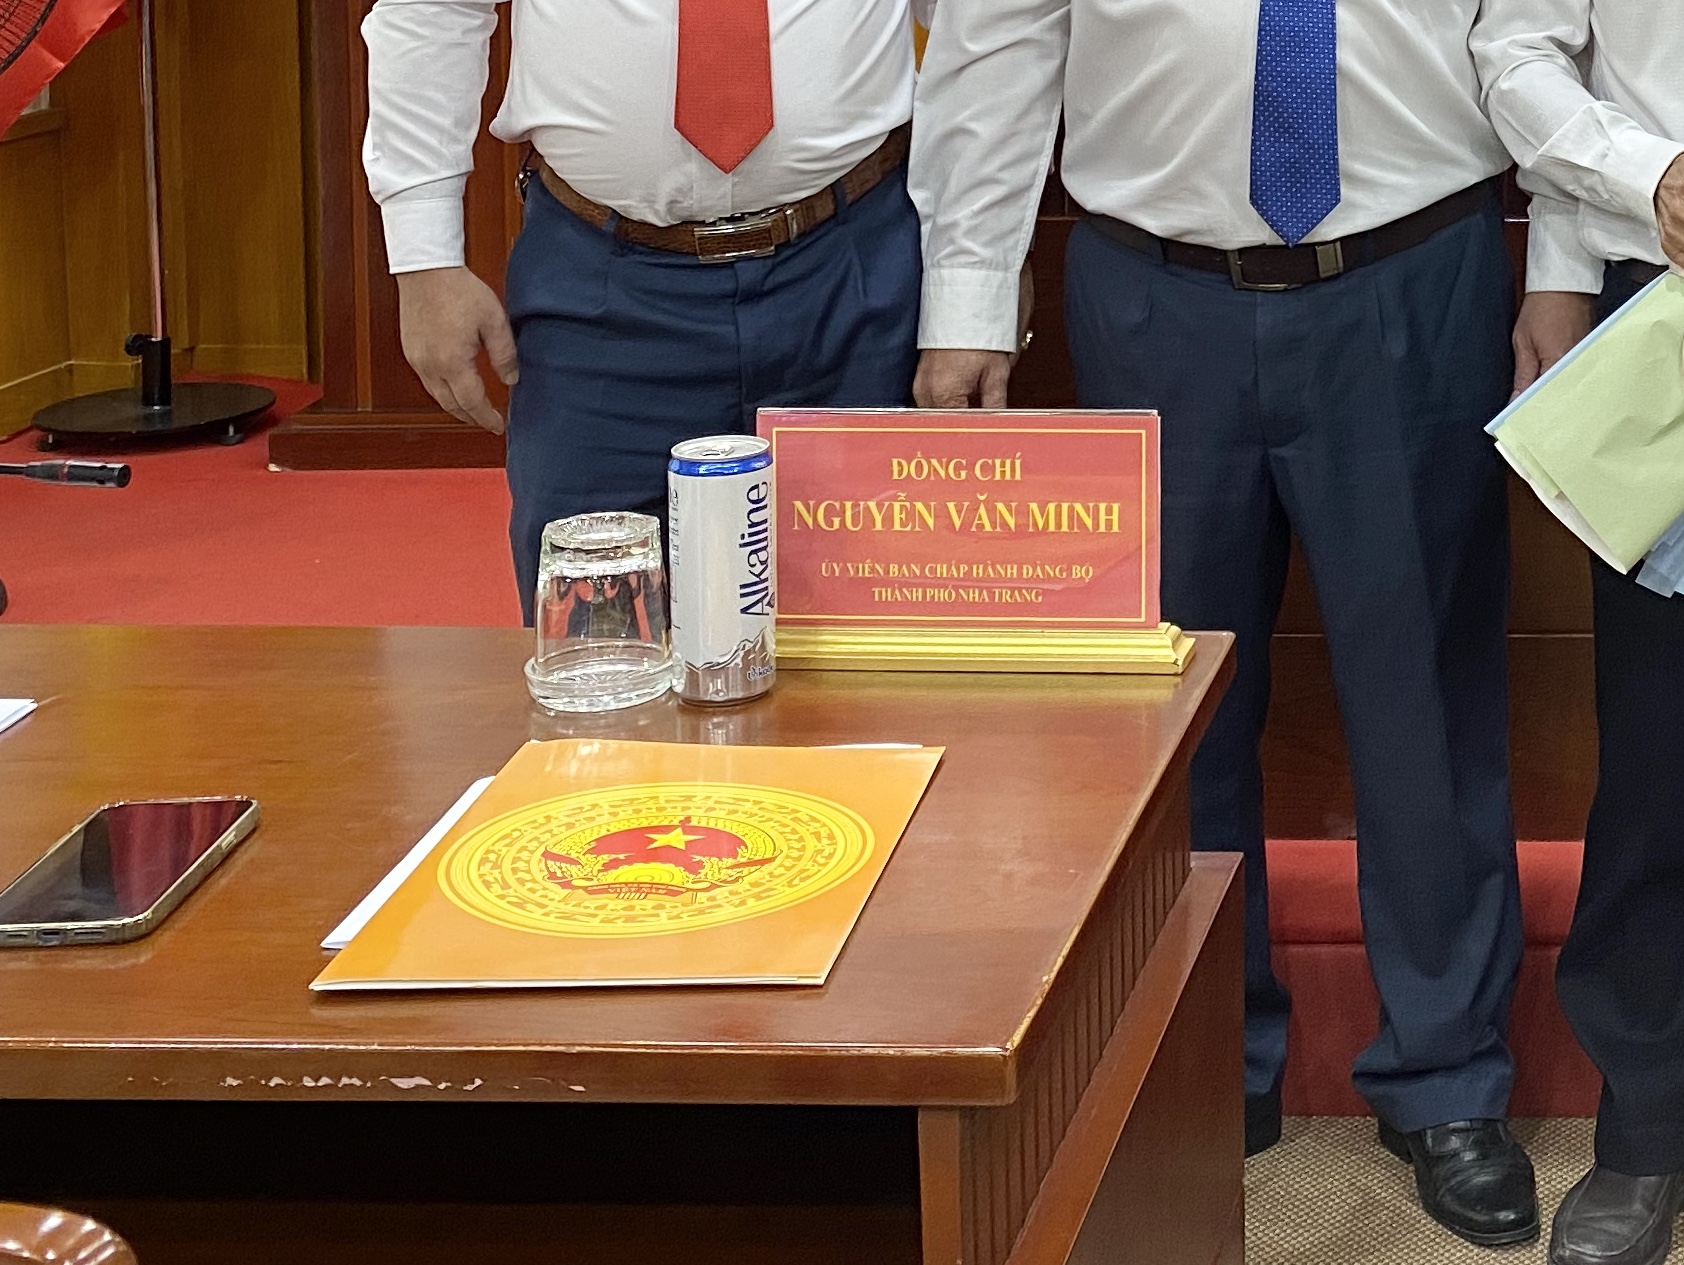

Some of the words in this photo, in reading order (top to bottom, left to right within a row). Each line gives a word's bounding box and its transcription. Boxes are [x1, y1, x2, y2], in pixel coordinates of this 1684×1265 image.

[974, 452, 1022, 481] CHÍ
[792, 492, 936, 532] NGUYỄN
[946, 493, 1018, 532] VĂN
[1028, 502, 1121, 533] MINH
[739, 481, 770, 616] Alkaline
[889, 563, 920, 578] BAN
[972, 560, 1018, 578] HÀNH
[872, 584, 923, 602] THÀNH
[958, 588, 989, 603] NHA
[993, 588, 1043, 603] TRANG
